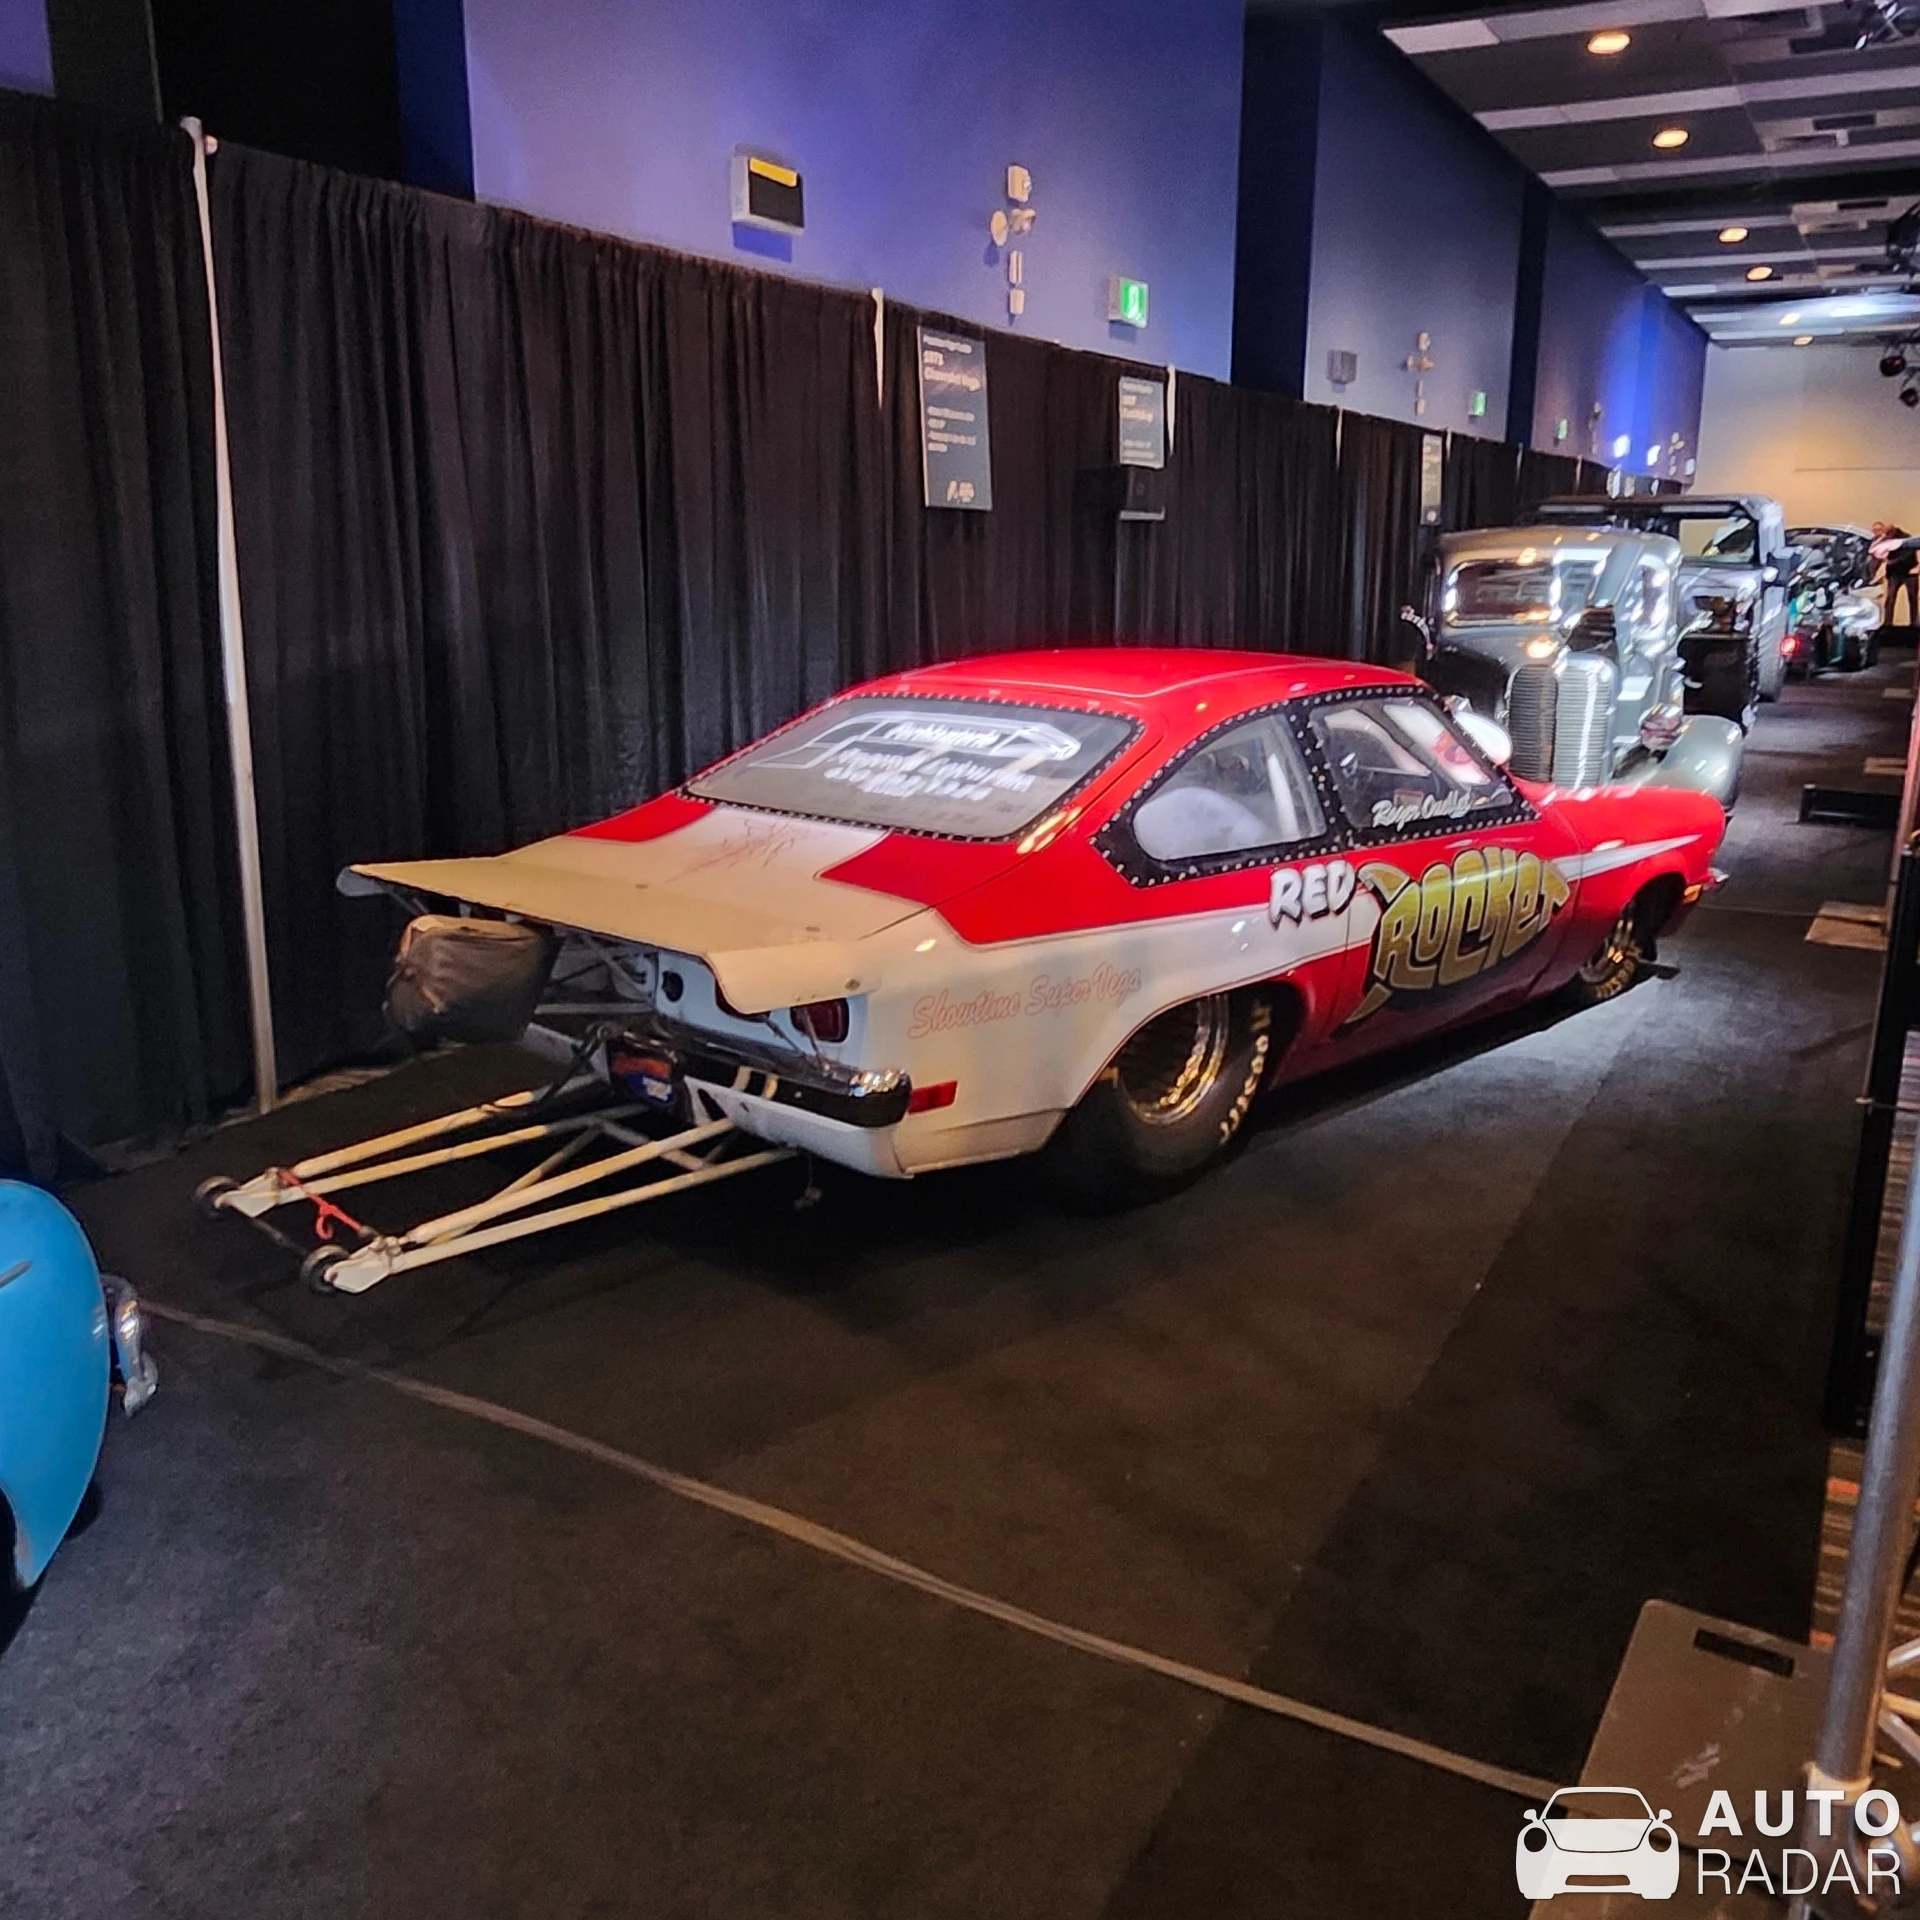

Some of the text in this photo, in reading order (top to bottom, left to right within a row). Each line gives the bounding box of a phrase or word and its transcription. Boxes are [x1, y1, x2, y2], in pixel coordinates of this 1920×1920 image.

[1268, 859, 1355, 930] RED
[907, 961, 1142, 1040] Showtime Super Vega
